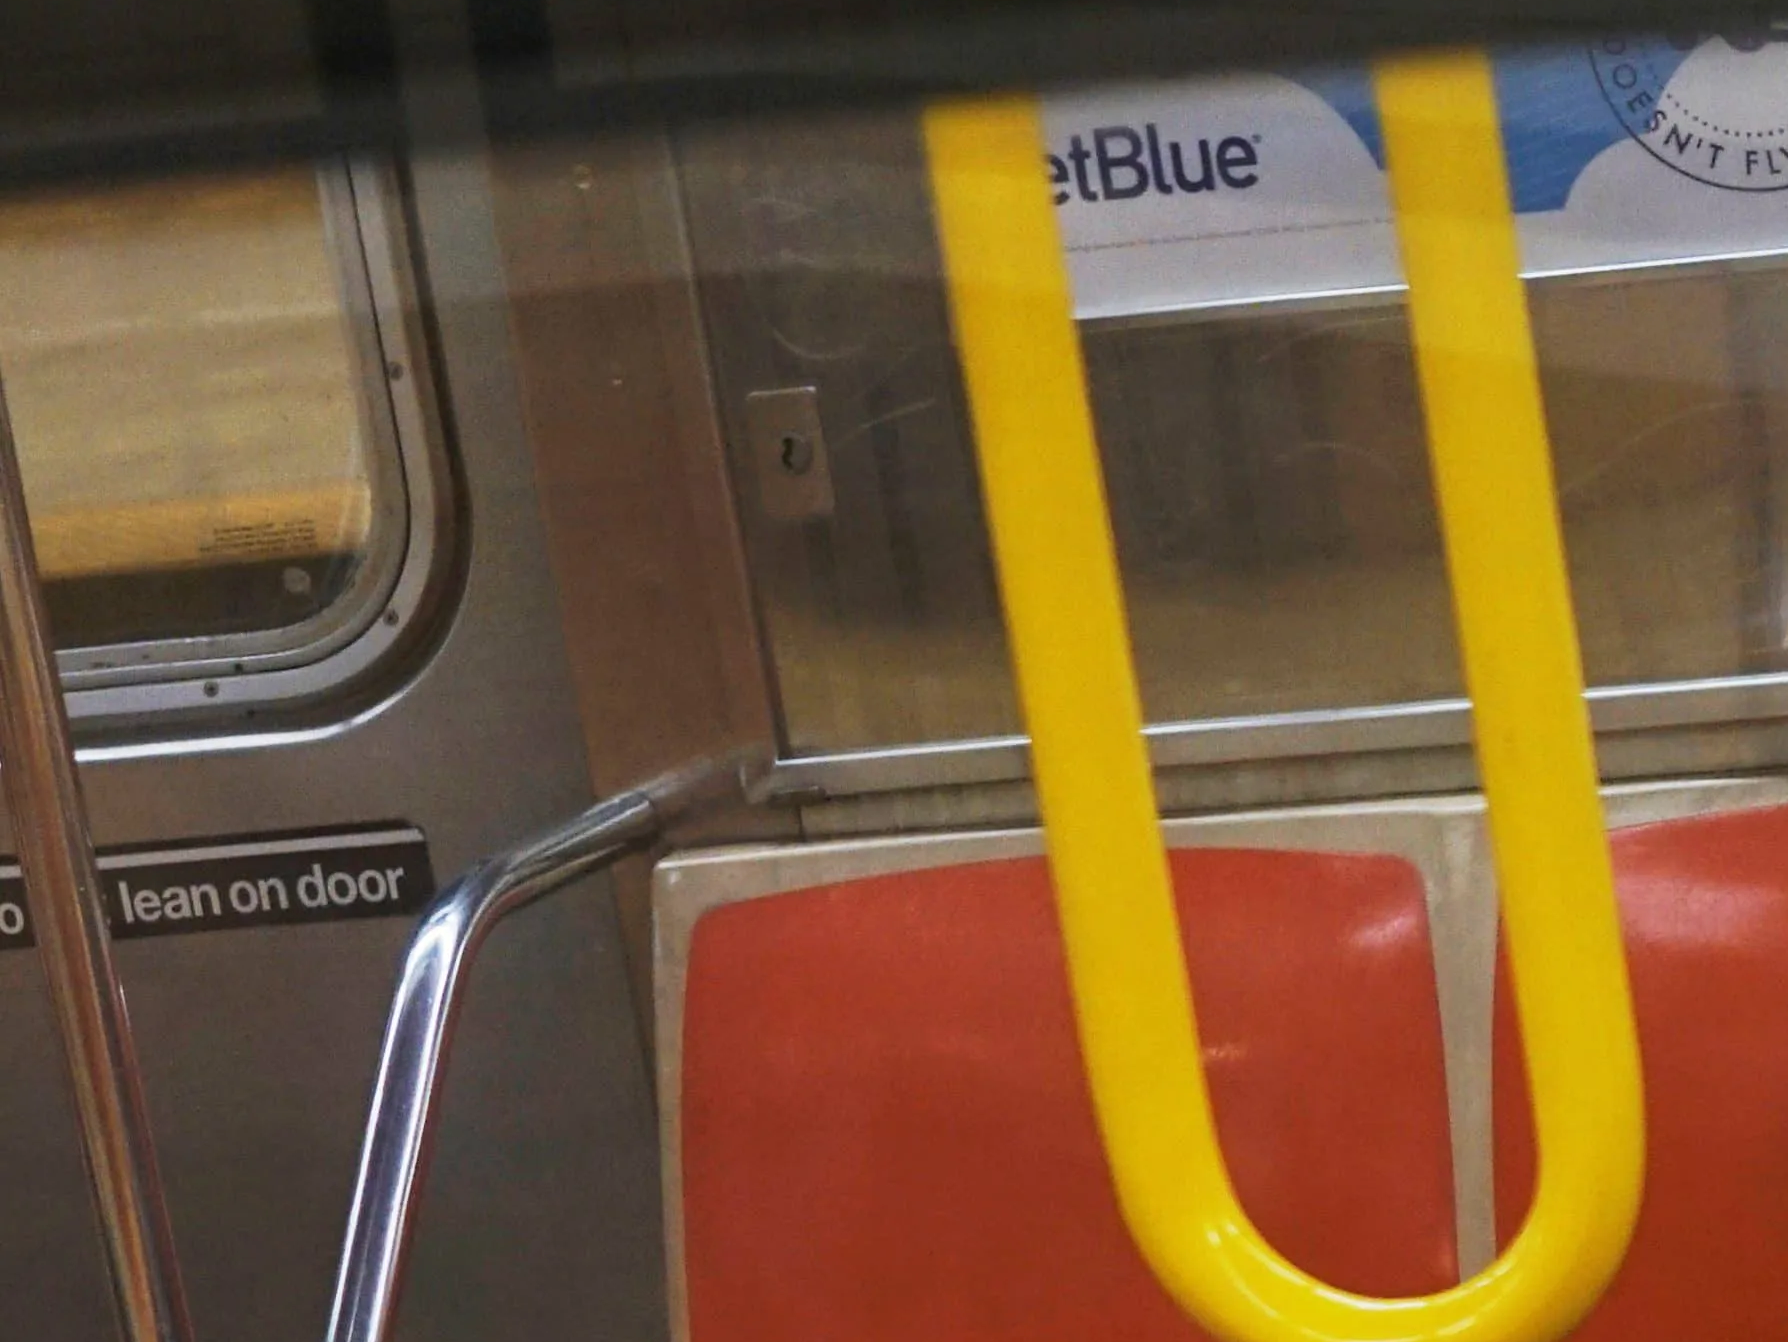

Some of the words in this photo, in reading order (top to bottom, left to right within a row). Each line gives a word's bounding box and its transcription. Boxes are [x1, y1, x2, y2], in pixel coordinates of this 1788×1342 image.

[1045, 124, 1259, 206] etBlue
[118, 880, 221, 924] lean
[229, 876, 289, 914] on
[297, 863, 405, 908] door
